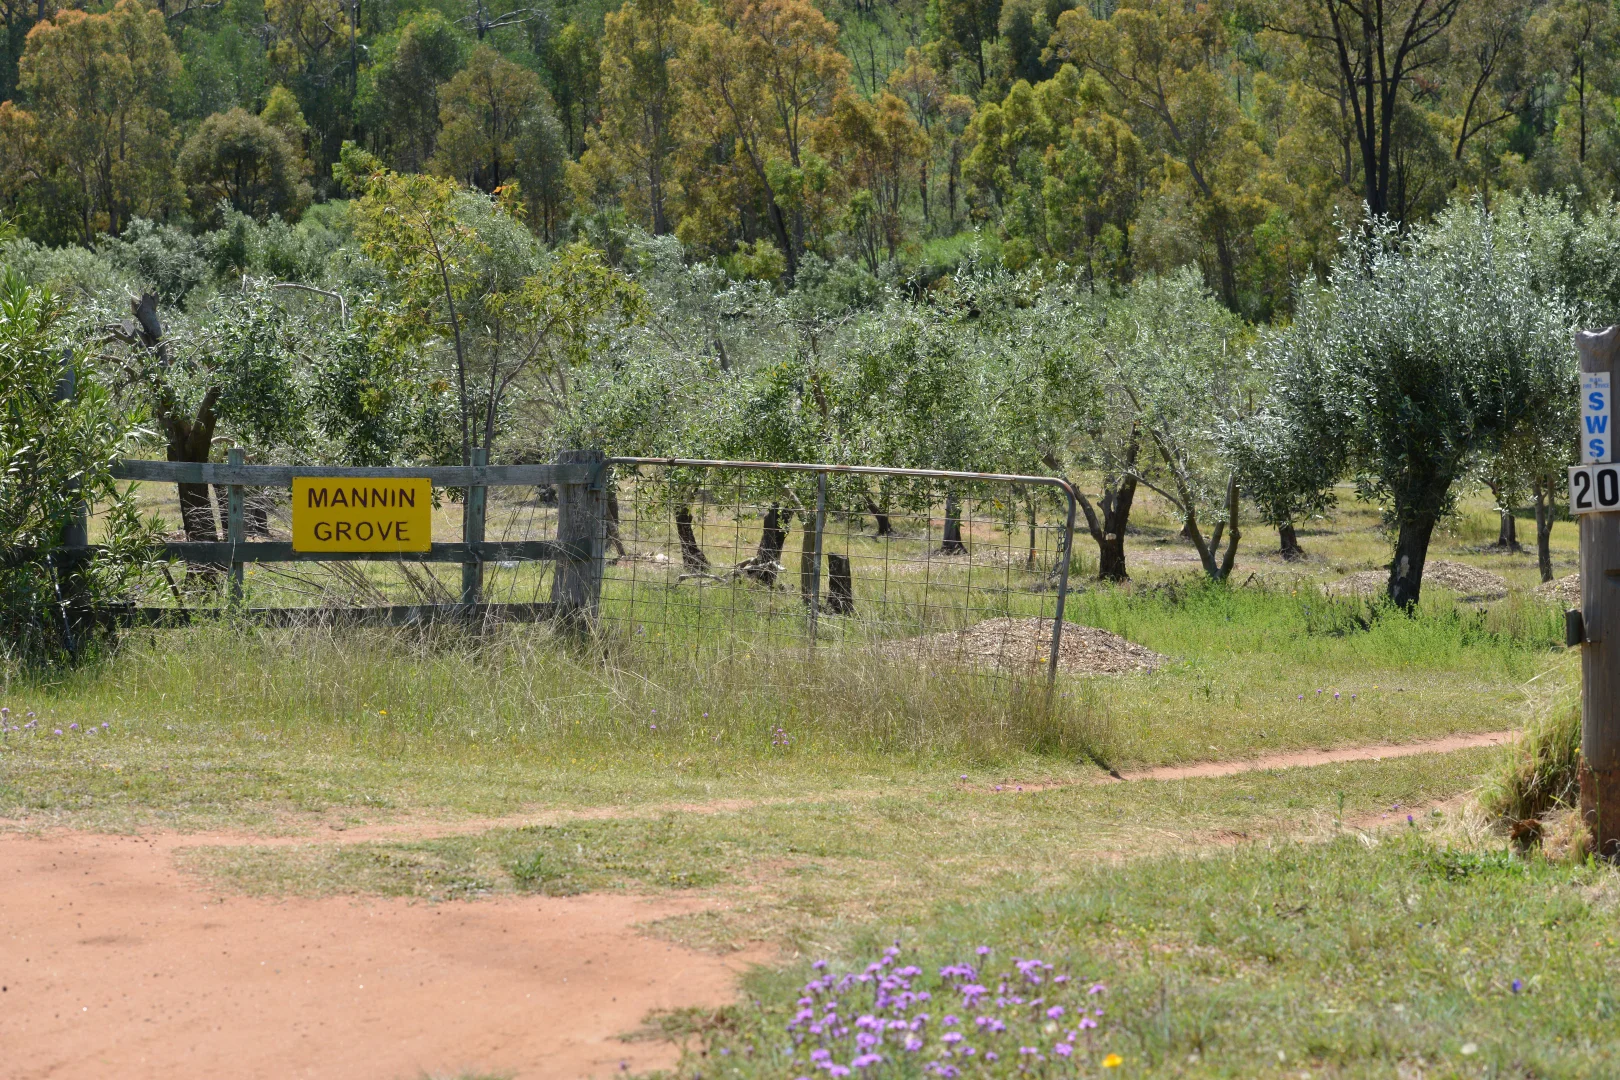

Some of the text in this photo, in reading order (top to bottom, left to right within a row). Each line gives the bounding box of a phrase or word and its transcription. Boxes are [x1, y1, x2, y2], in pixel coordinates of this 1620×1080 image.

[1585, 392, 1608, 457] SWS
[308, 487, 415, 508] MANNIN
[1574, 469, 1619, 508] 20
[314, 521, 410, 541] GROVE
